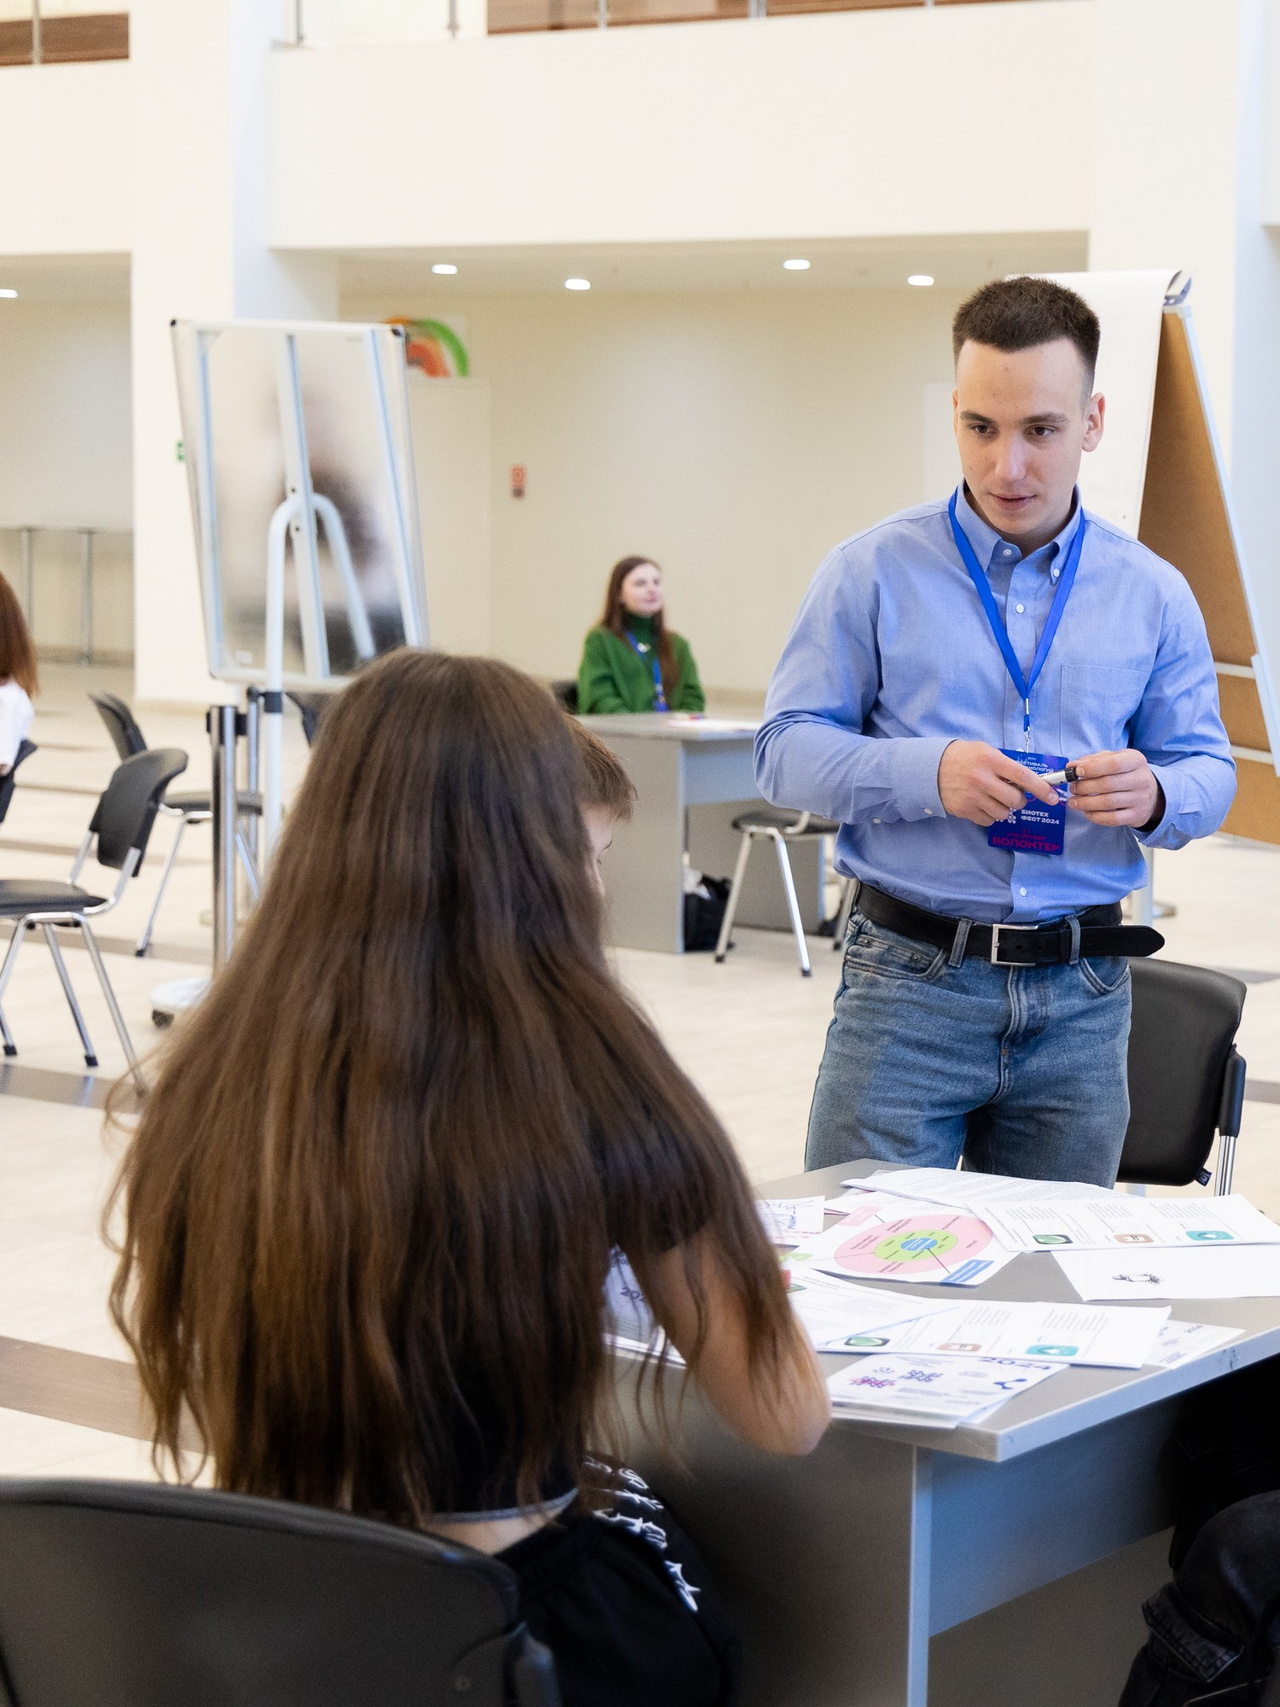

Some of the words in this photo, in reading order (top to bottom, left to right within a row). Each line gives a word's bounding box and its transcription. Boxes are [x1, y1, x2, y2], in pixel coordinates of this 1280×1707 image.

[1020, 815, 1041, 823] ФЕСТ
[1021, 809, 1049, 818] БИОТЕХ
[992, 836, 1060, 851] ВОЛОНТЕР
[978, 1357, 1052, 1370] 2024
